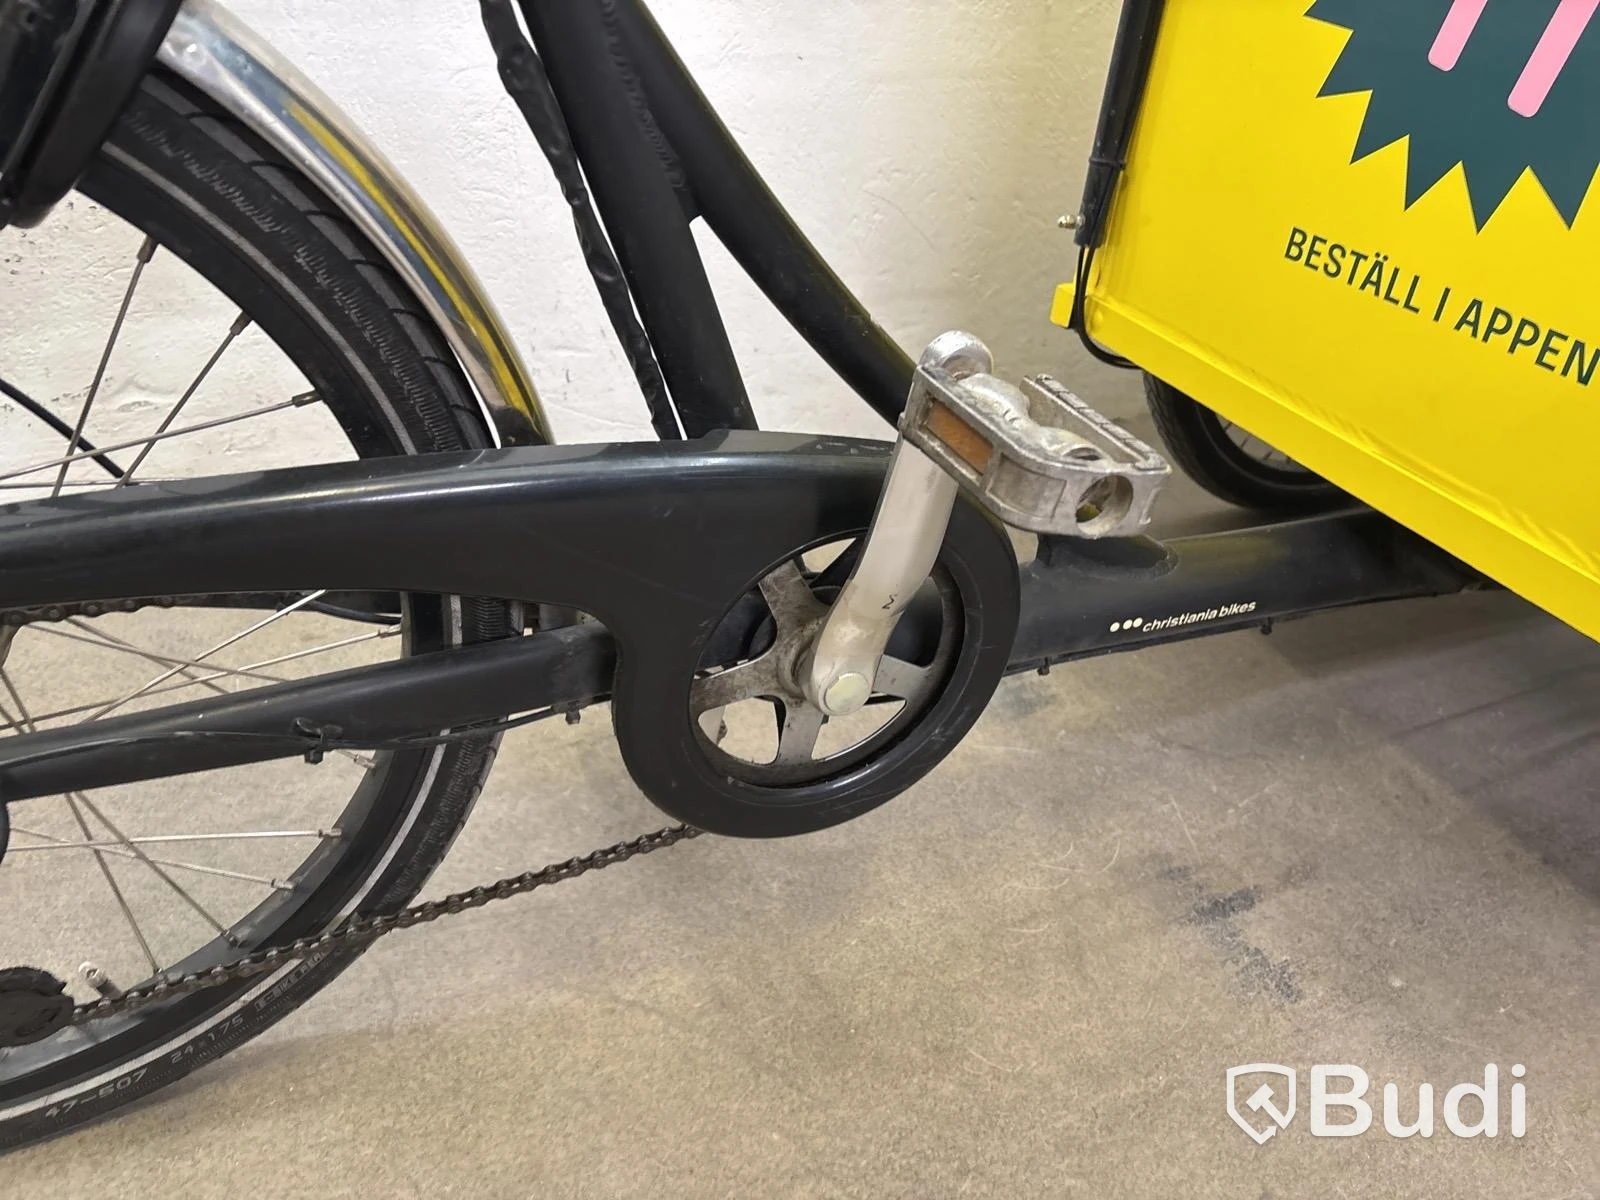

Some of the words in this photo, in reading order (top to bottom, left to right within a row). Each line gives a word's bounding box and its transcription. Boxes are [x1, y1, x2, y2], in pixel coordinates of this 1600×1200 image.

[1284, 226, 1421, 314] BESTÄLL
[1432, 286, 1452, 323] I
[1453, 297, 1600, 387] APPEN
[1142, 608, 1217, 632] christiania
[1218, 600, 1257, 618] bikes
